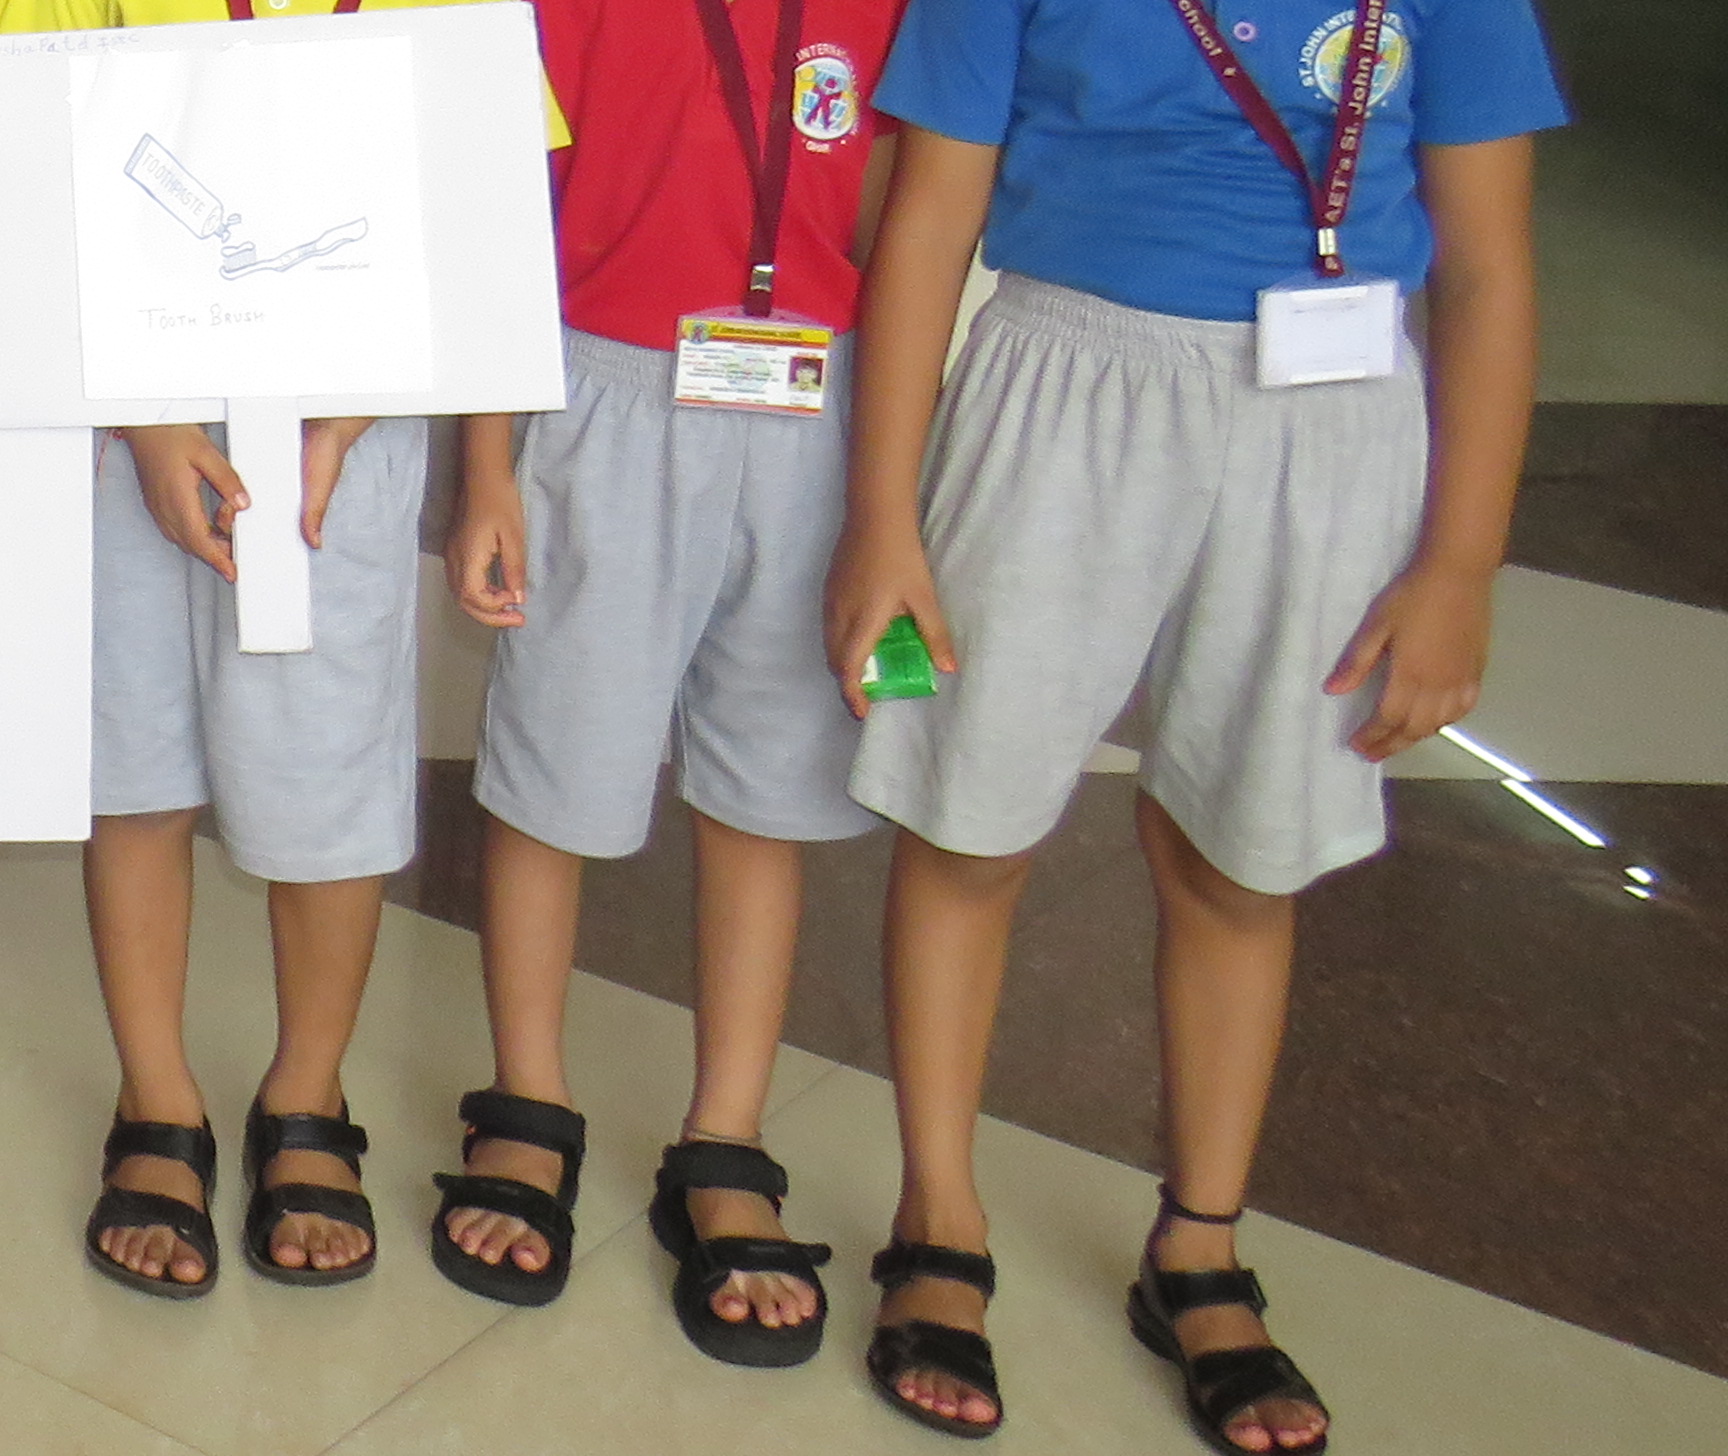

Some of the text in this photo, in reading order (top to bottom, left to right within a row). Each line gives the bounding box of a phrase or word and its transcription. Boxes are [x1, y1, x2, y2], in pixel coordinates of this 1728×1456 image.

[1299, 26, 1328, 65] JOHN
[1348, 56, 1373, 115] John
[143, 151, 206, 217] TOOTHPASTE
[137, 303, 265, 330] TOOTH BRUSH
